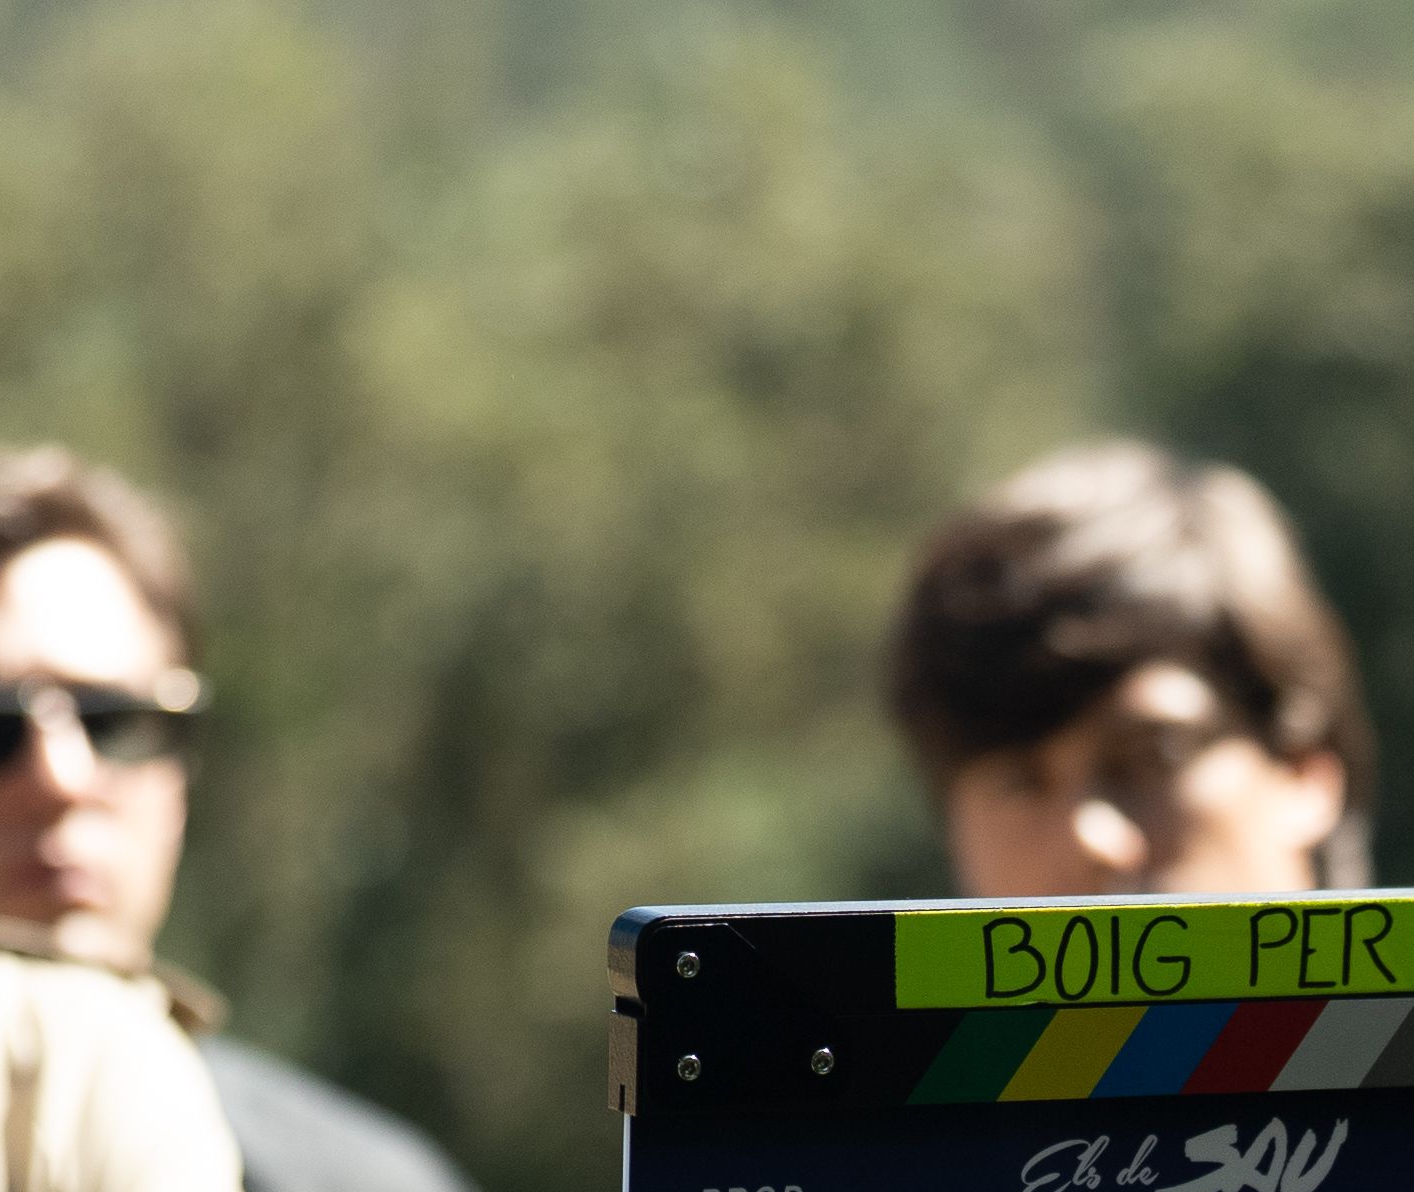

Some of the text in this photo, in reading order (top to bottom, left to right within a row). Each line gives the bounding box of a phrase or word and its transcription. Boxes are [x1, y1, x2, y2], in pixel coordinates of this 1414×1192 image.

[983, 914, 1190, 1000] BOIG
[1249, 903, 1397, 989] PER
[1116, 1134, 1158, 1187] de
